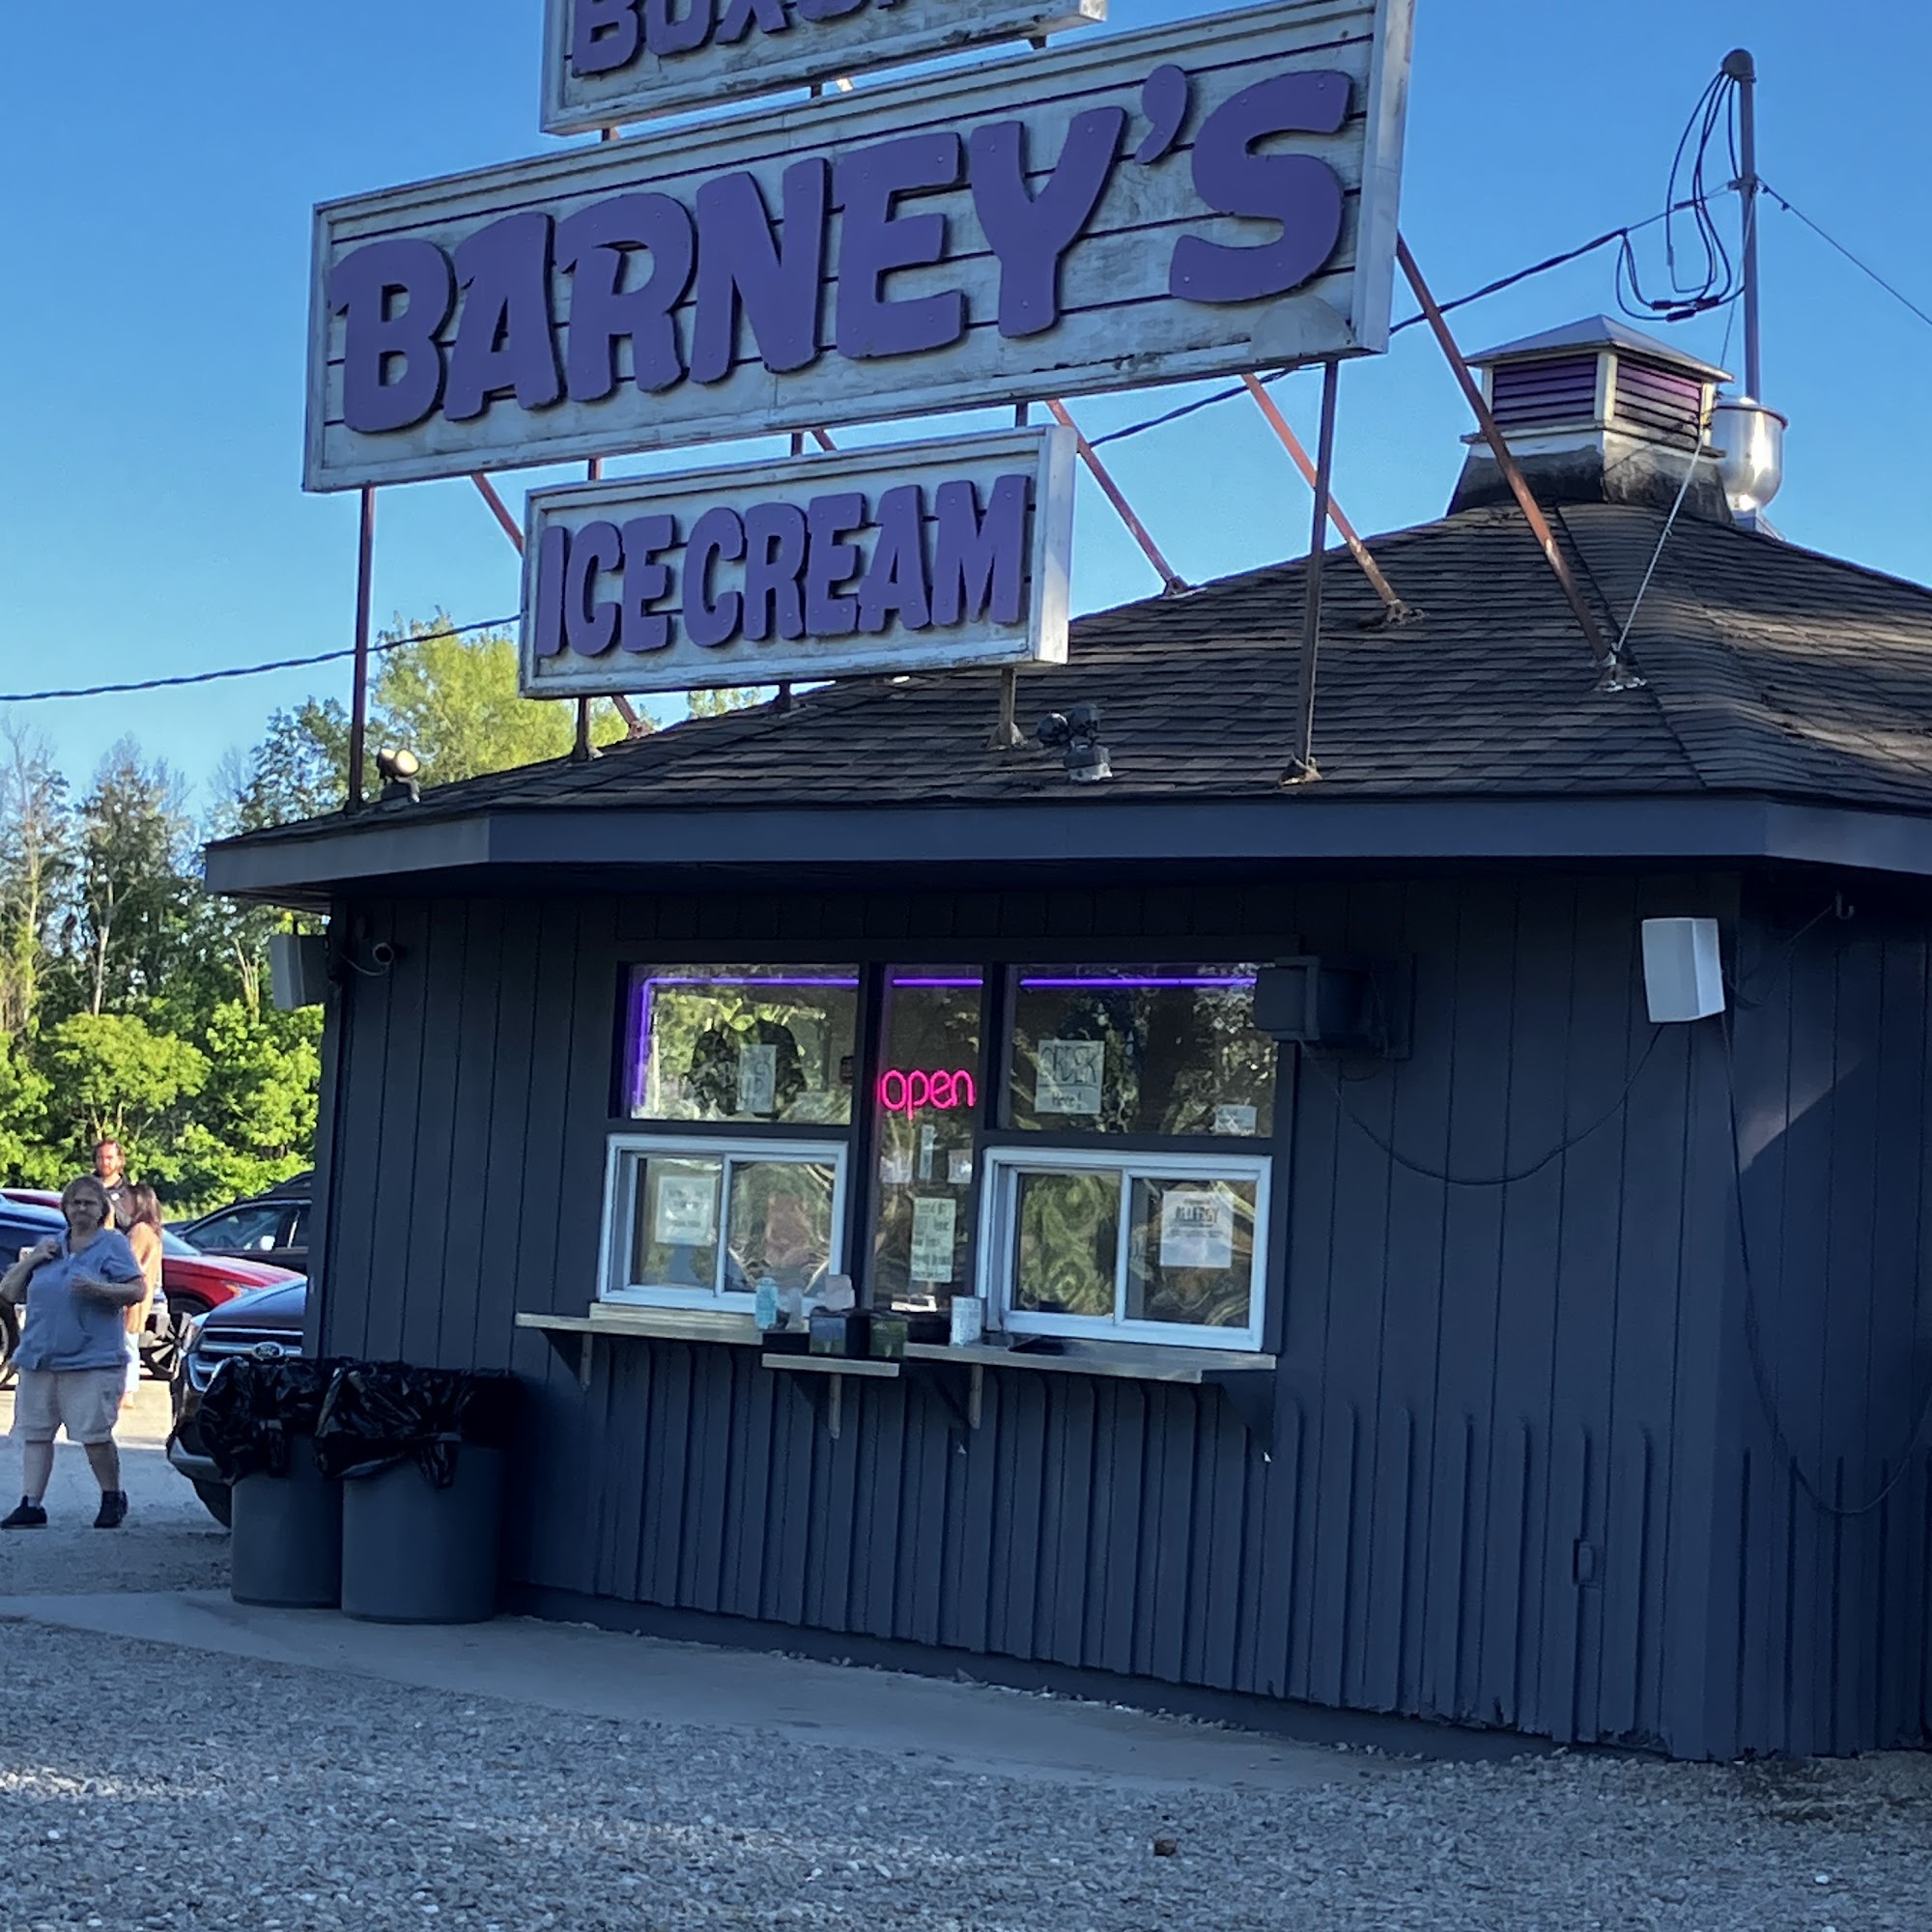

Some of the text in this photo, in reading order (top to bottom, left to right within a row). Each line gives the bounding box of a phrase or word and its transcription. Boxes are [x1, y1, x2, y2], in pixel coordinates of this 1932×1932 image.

[328, 65, 1354, 434] BARNEY'S
[536, 473, 1031, 657] ICE CREAM
[880, 1068, 976, 1122] open
